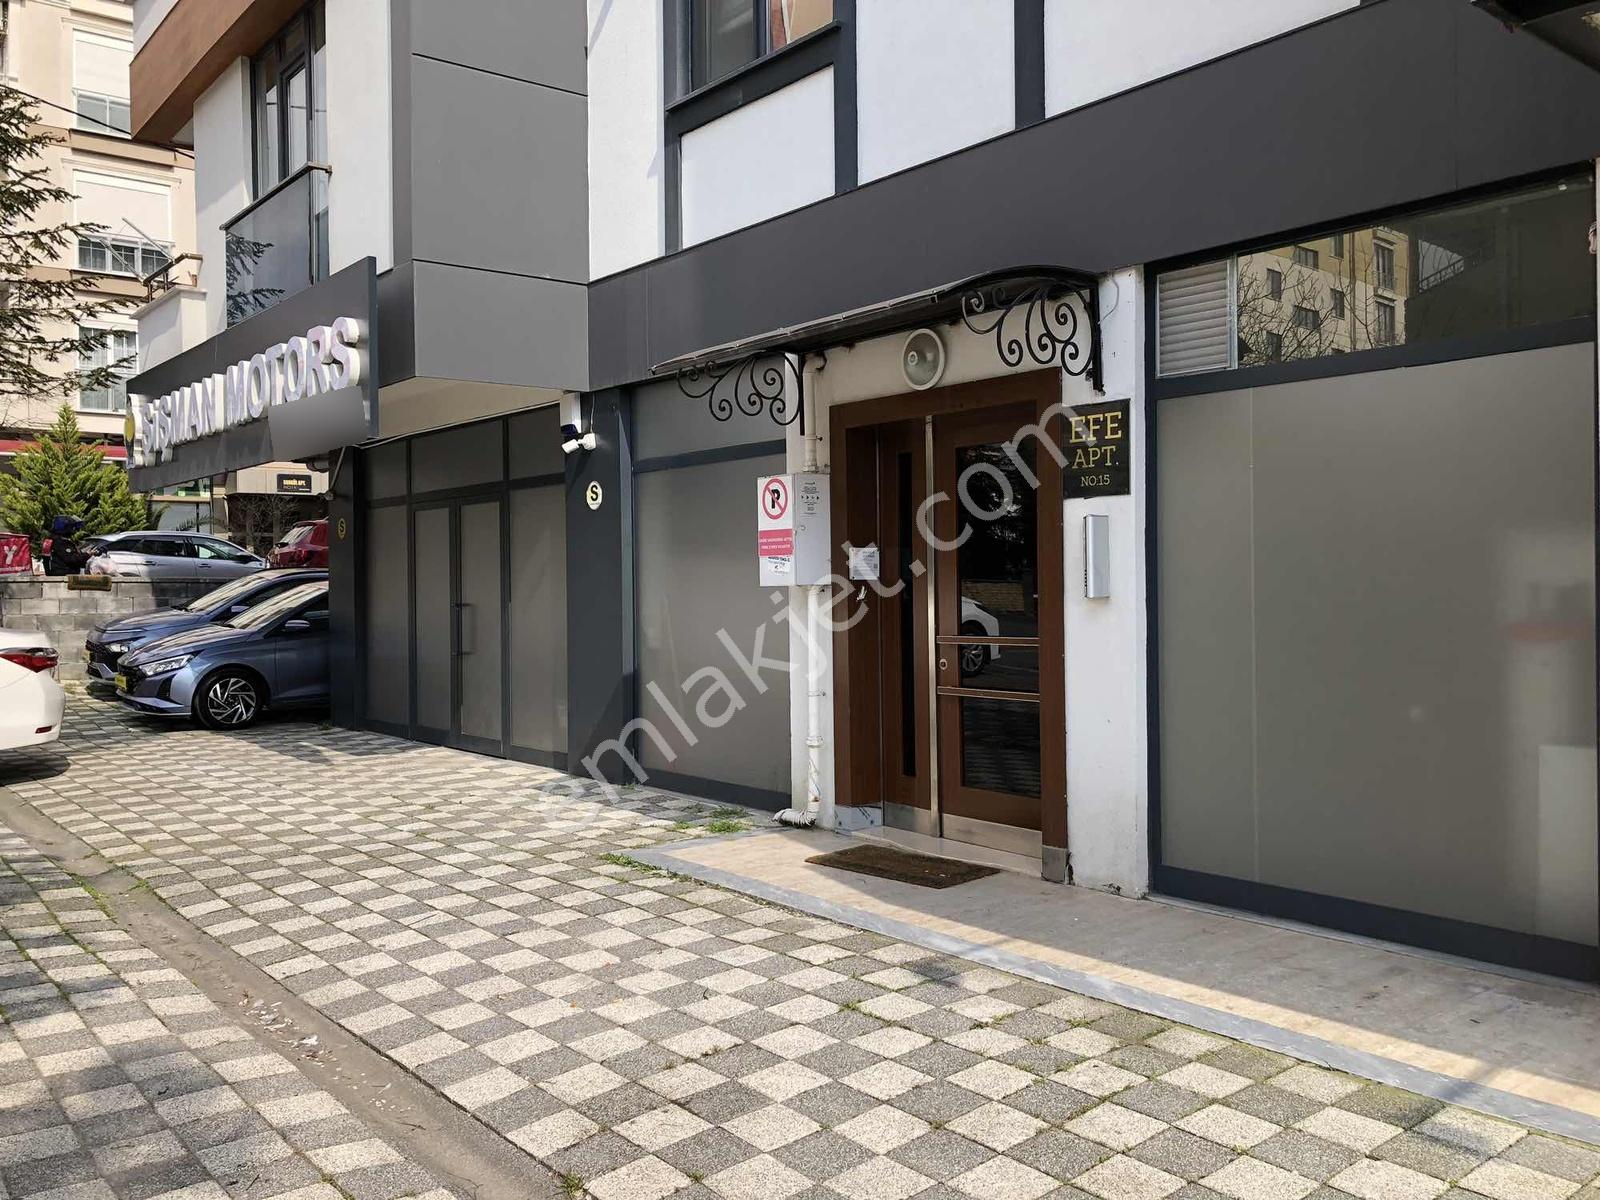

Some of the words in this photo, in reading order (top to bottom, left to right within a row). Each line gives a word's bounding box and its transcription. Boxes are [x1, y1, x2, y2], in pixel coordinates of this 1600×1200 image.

[226, 316, 361, 426] MOTORS
[1069, 411, 1122, 443] EFE
[1072, 445, 1119, 469] APT.
[590, 484, 599, 502] S
[771, 488, 781, 509] P
